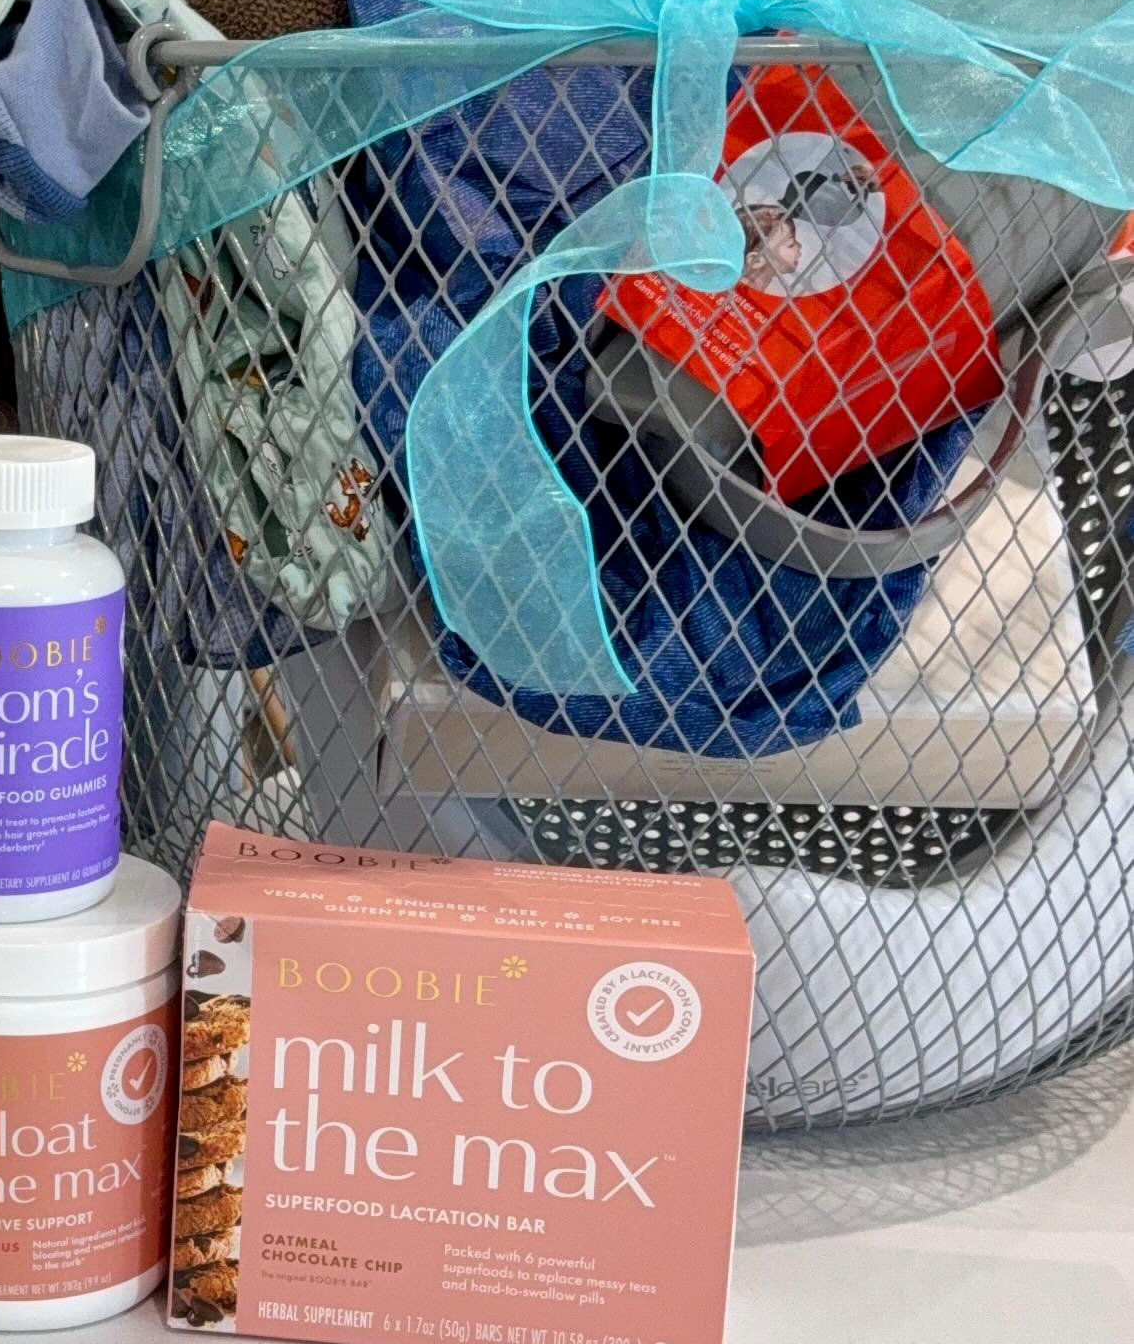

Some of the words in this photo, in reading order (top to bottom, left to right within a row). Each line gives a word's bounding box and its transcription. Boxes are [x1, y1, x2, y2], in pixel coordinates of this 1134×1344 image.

[633, 279, 655, 303] dans
[49, 774, 108, 801] GUMMIES
[5, 815, 28, 827] treat
[30, 815, 40, 826] to
[41, 811, 77, 827] promote
[4, 829, 24, 840] hair
[26, 826, 59, 841] growth
[238, 841, 429, 873] BOOBIE
[26, 870, 71, 889] SUPPLEMENT
[493, 866, 584, 879] SUPERFOOD
[586, 873, 669, 885] LACTATION
[671, 880, 702, 888] BAR
[263, 887, 324, 901] VEGAN
[385, 896, 488, 914] FENUGREEK
[499, 906, 538, 917] FREE
[599, 913, 637, 926] SOY
[641, 917, 682, 928] FREE
[324, 903, 394, 916] GLUTEN
[398, 908, 438, 920] FREE
[494, 916, 548, 928] DAIRY
[554, 920, 595, 932] FREE
[277, 958, 498, 1007] BOOBIE
[602, 980, 617, 995] BY
[619, 973, 629, 984] A
[630, 969, 693, 1008] LACTATION
[595, 996, 620, 1043] CREATED
[622, 1009, 693, 1054] CONSULTANT
[273, 1018, 465, 1104] milk
[494, 1043, 593, 1115] to
[265, 1093, 419, 1180] the
[53, 1151, 142, 1201] max
[26, 1210, 94, 1231] SUPPORT
[264, 1192, 385, 1218] SUPERFOOD
[389, 1202, 500, 1231] LACTATION
[507, 1213, 547, 1235] BAR
[32, 1238, 69, 1250] Natural
[71, 1229, 117, 1247] ingredients
[32, 1249, 72, 1261] bloating
[73, 1244, 91, 1256] and
[262, 1233, 339, 1252] OATMEAL
[32, 1261, 43, 1272] to
[44, 1260, 60, 1271] the
[261, 1249, 359, 1270] CHOCOLATE
[364, 1258, 403, 1274] CHIP
[443, 1244, 491, 1261] Packed
[495, 1248, 521, 1263] with
[525, 1251, 534, 1264] 6
[538, 1255, 597, 1271] powerful
[442, 1261, 514, 1279] superfoods
[517, 1269, 530, 1281] to
[533, 1270, 583, 1288] replace
[586, 1278, 626, 1294] messy
[629, 1281, 658, 1295] teas
[441, 1279, 468, 1292] and
[470, 1278, 576, 1303] hard-to-swallow
[579, 1292, 606, 1306] pills
[258, 1300, 299, 1323] HERBAL
[303, 1304, 375, 1330] SUPPLEMENT
[383, 1312, 391, 1332] 6
[394, 1318, 402, 1332] x
[406, 1314, 435, 1336] 1.7oz
[439, 1317, 471, 1344] (50g)
[475, 1321, 503, 1343] BARS
